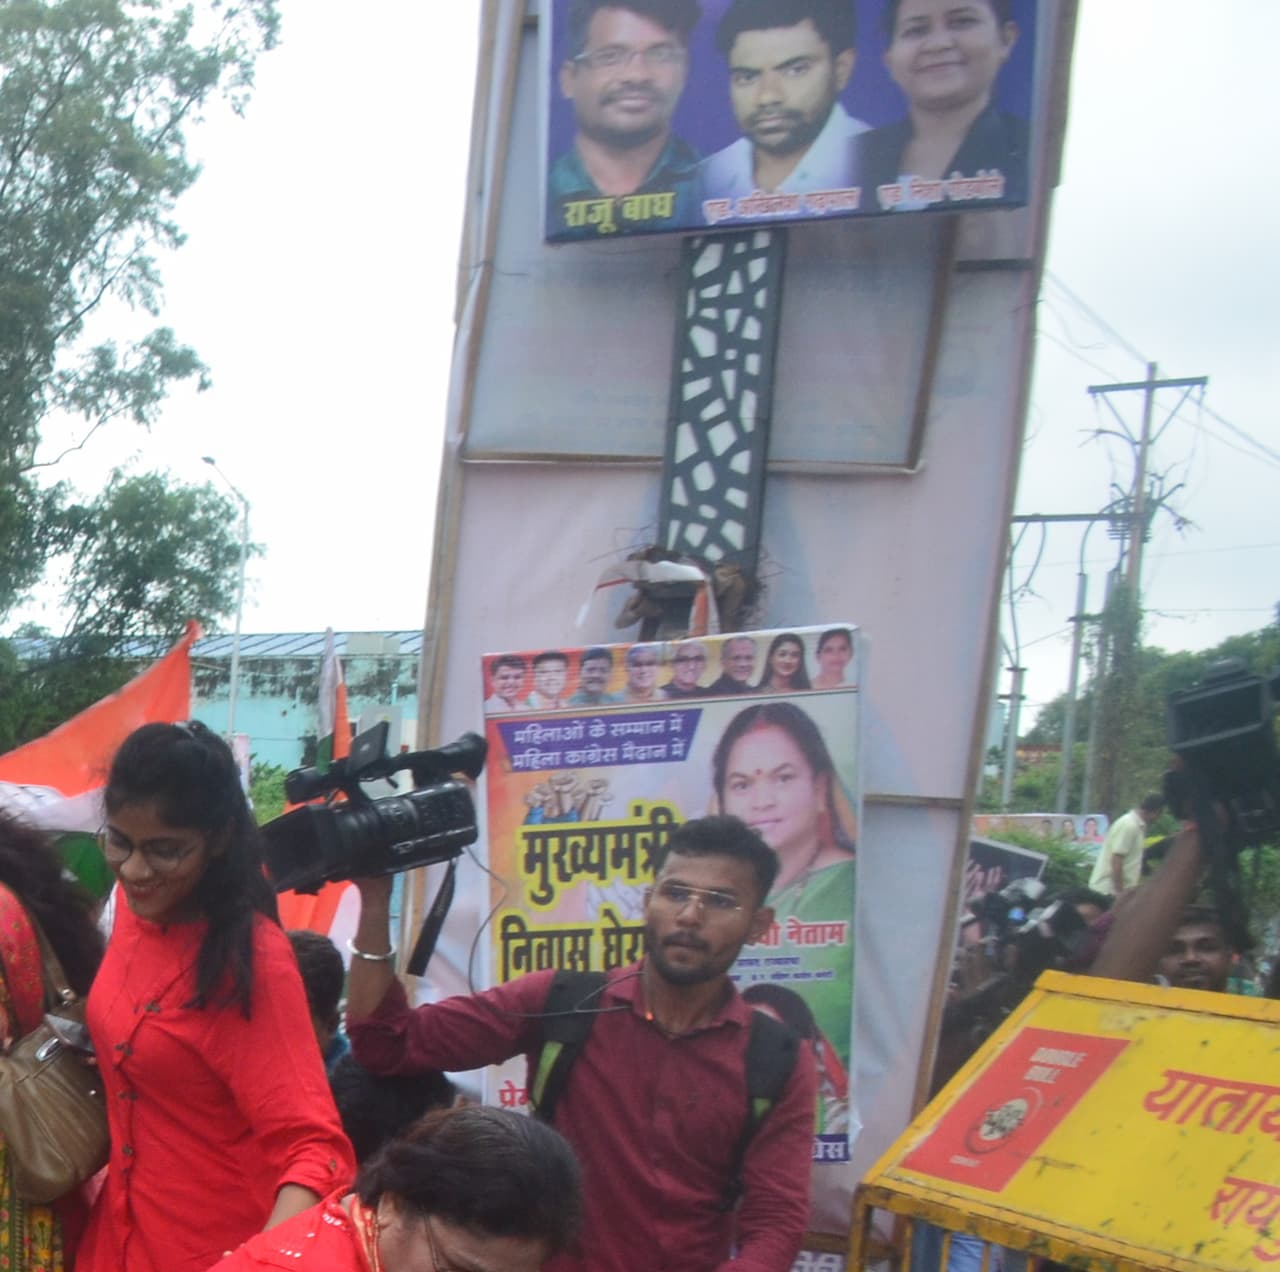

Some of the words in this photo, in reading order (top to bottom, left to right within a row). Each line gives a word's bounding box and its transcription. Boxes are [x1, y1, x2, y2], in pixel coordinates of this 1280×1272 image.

[513, 720, 586, 744] महिलाओं
[590, 718, 606, 738] के
[610, 720, 665, 737] सम्मान
[669, 713, 684, 733] में
[513, 750, 561, 770] महिला
[564, 744, 618, 764] कांग्रेस
[621, 741, 667, 761] मैदान
[671, 738, 685, 758] में
[522, 804, 680, 906] मुख्यमंत्री
